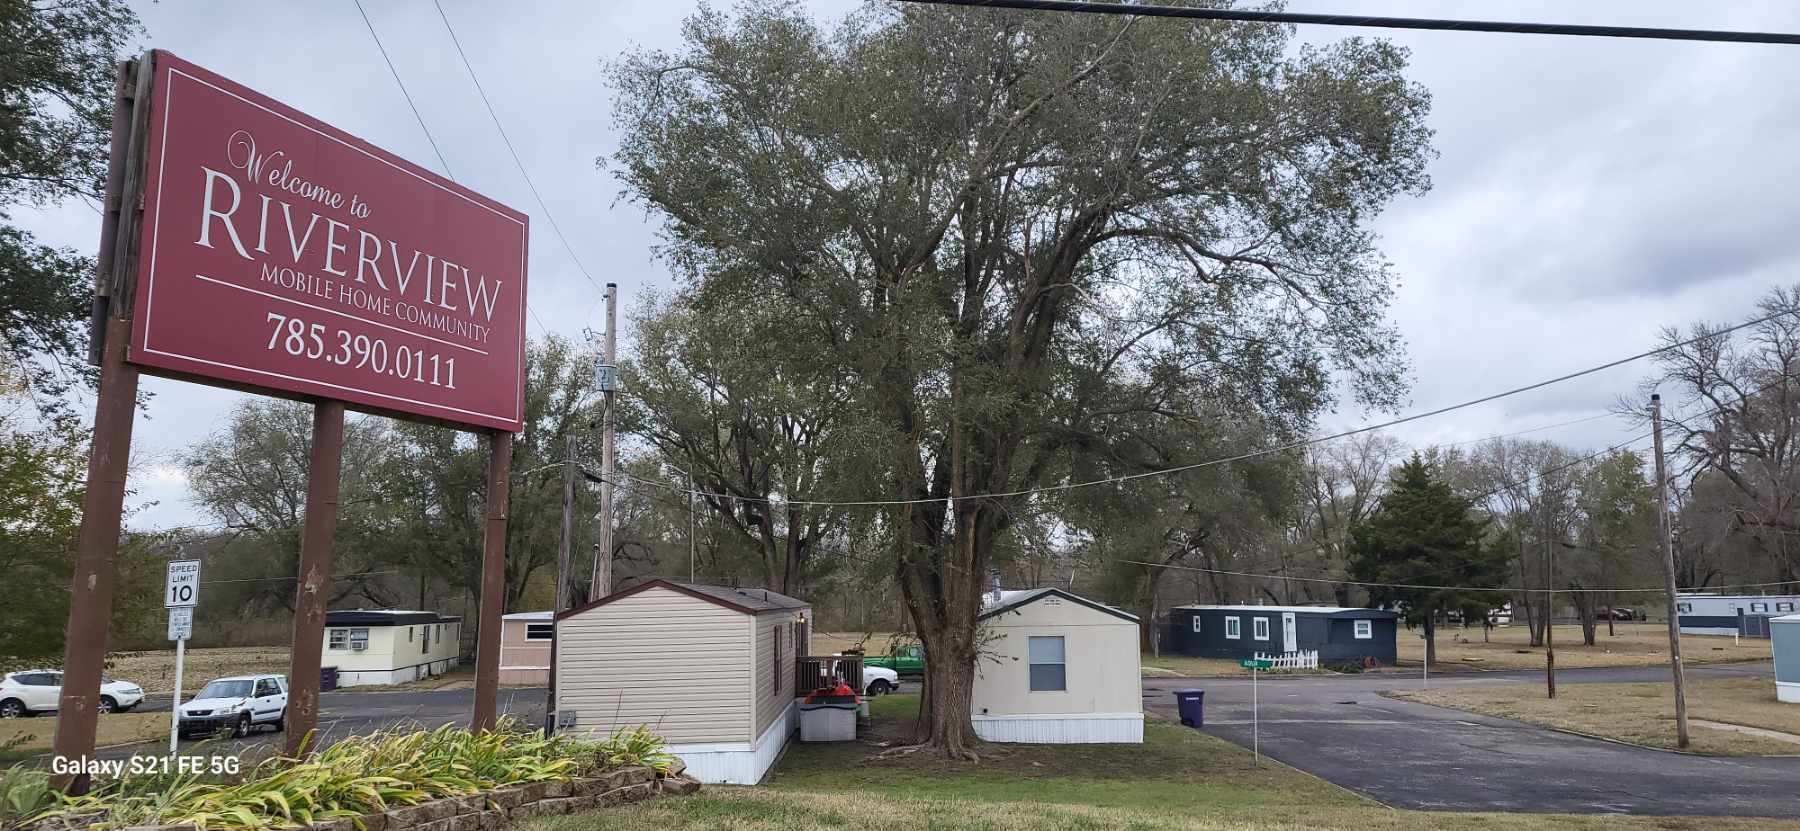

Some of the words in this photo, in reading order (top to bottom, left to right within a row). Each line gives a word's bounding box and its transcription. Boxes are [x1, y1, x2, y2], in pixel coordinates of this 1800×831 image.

[227, 130, 344, 209] Welcome
[350, 193, 371, 219] to
[194, 166, 502, 322] RIVERVIEW
[261, 262, 333, 300] MOBILE
[339, 286, 391, 317] HOME
[395, 303, 490, 344] COMMUNITY
[266, 312, 456, 389] 785.390.0111
[170, 565, 197, 573] SPEED
[172, 585, 192, 602] 10
[173, 575, 194, 583] LIMIT
